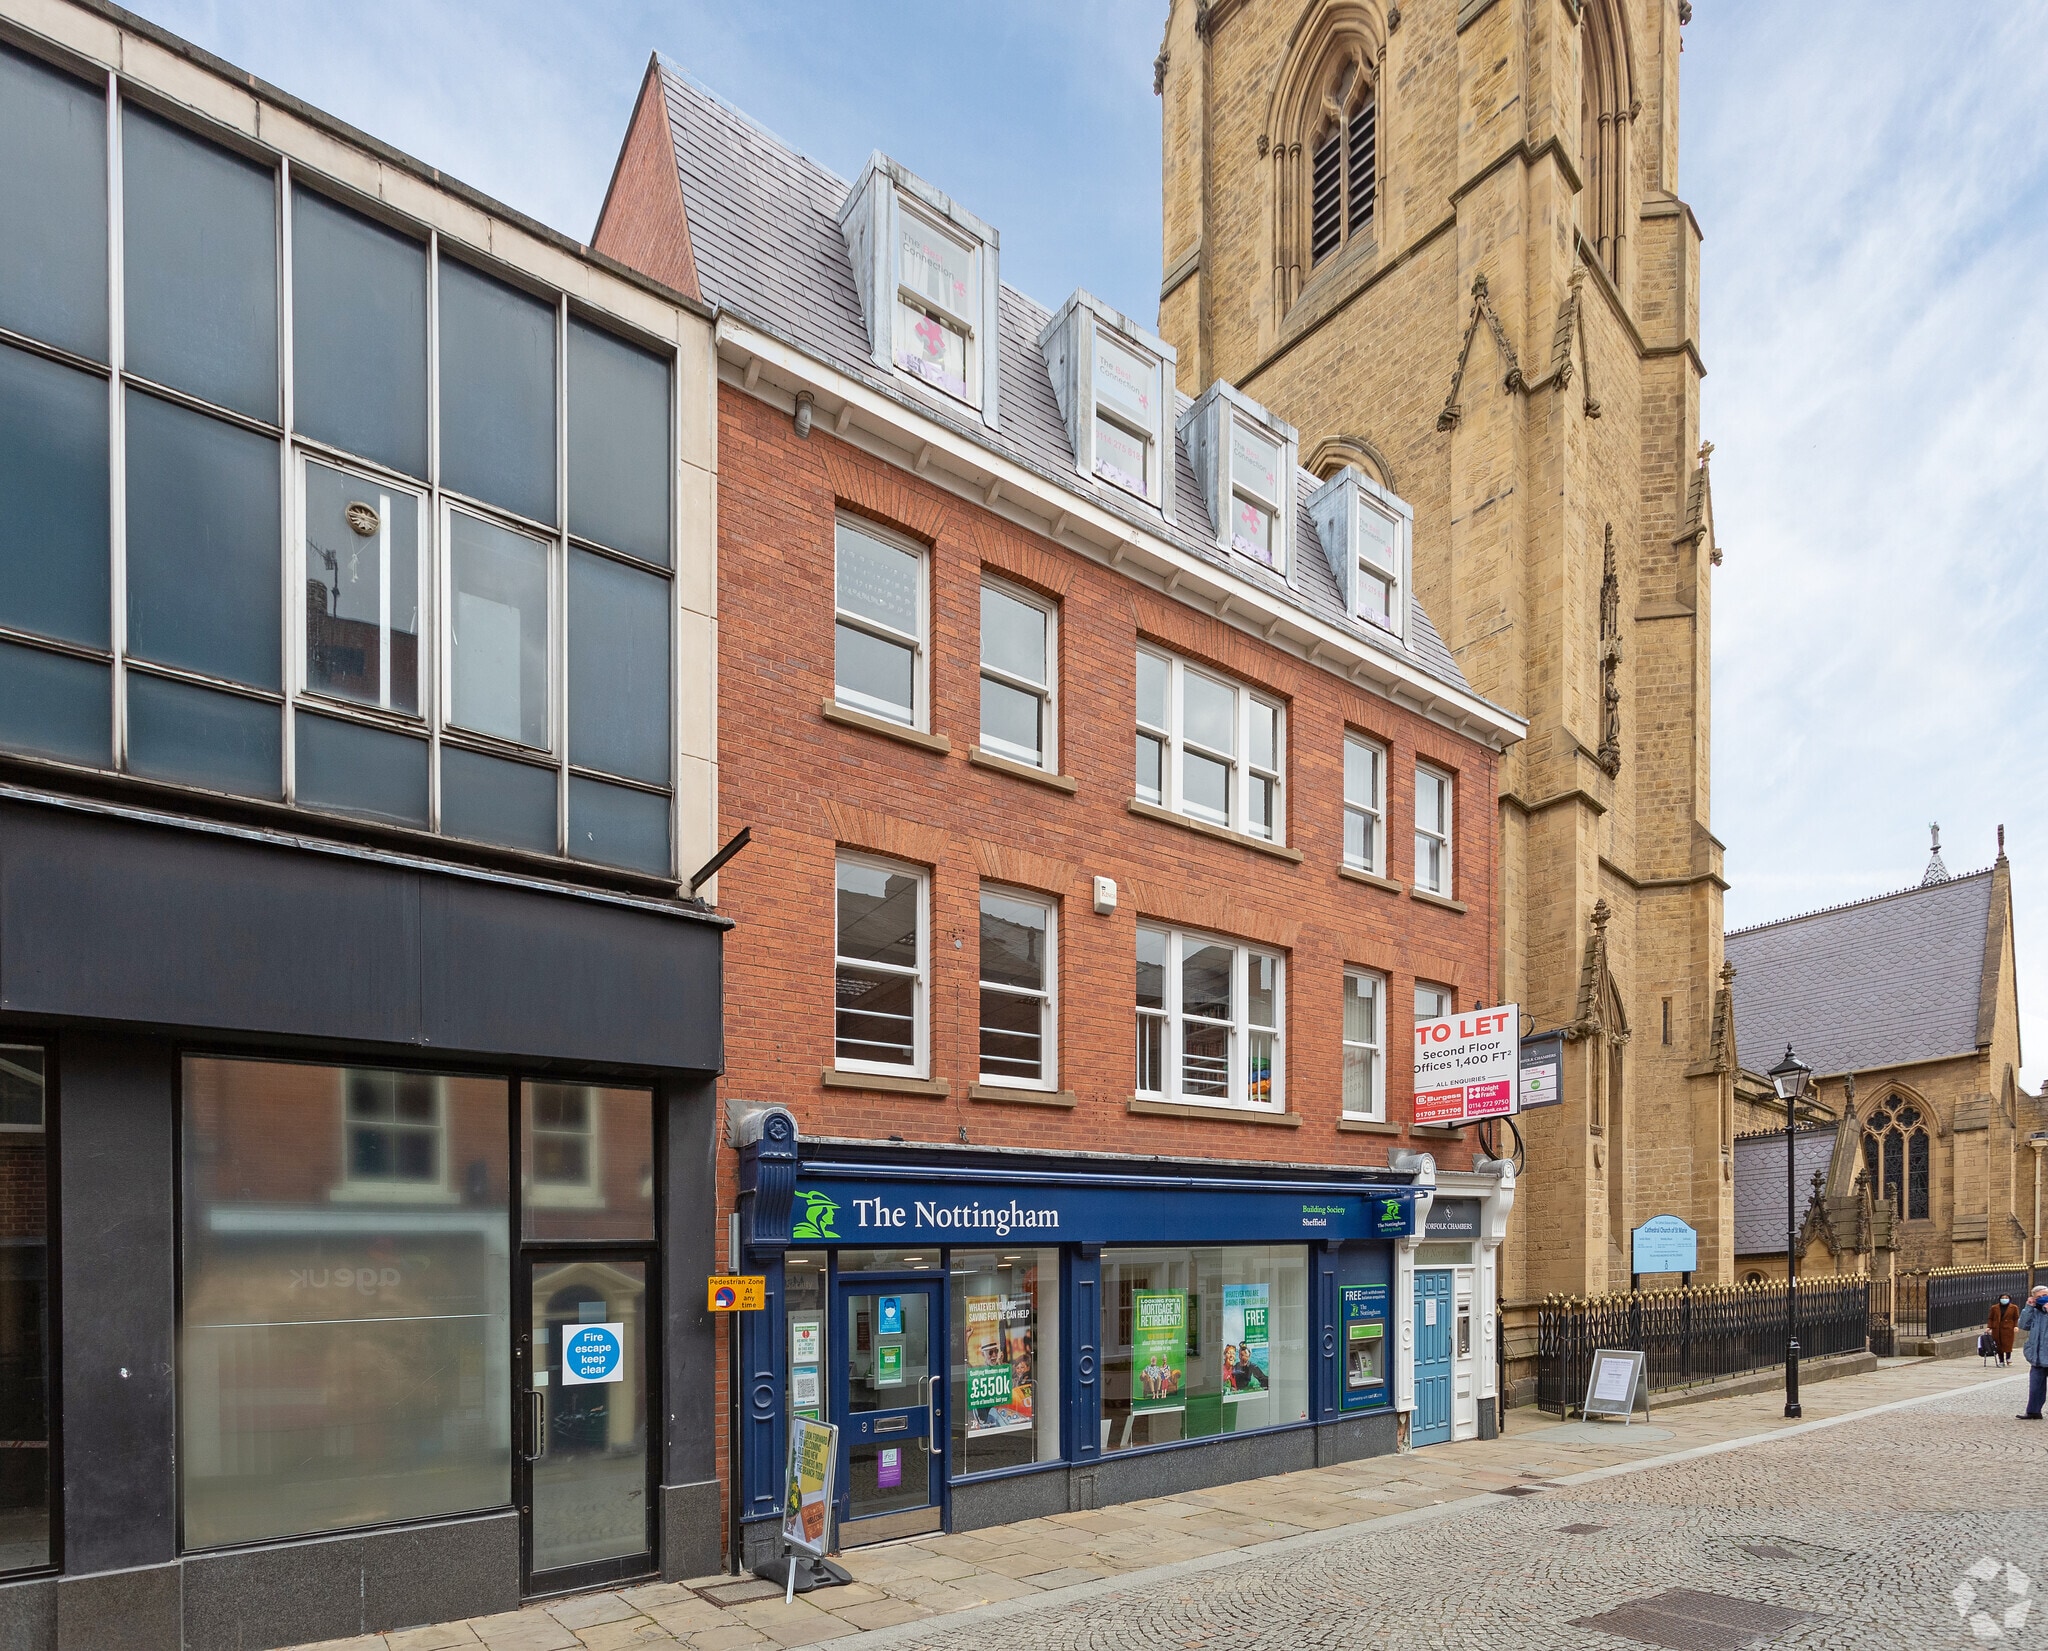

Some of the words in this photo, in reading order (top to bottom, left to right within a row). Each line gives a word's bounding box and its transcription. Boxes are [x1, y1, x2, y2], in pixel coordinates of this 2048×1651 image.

[904, 231, 920, 248] The
[903, 242, 954, 280] Connection
[1100, 356, 1113, 370] The
[1100, 366, 1140, 395] Connection
[1416, 1023, 1451, 1045] TO
[1460, 1013, 1509, 1038] LET
[1423, 1045, 1465, 1060] Second
[1469, 1041, 1500, 1053] Floor
[1414, 1061, 1452, 1074] Offices
[1456, 1054, 1488, 1069] 1,400
[1450, 1075, 1486, 1087] ENQUIRIES
[1480, 1085, 1499, 1093] Knight
[1427, 1093, 1461, 1103] Burgess
[853, 1196, 906, 1227] The
[914, 1199, 1059, 1236] Nottingham
[1302, 1205, 1326, 1215] Building
[1326, 1205, 1345, 1215] Society
[1302, 1218, 1327, 1226] Sheffield
[1424, 1222, 1447, 1230] NORFOLK
[1447, 1222, 1472, 1230] CHAMBERS
[1226, 1290, 1245, 1298] WHATEVER
[1345, 1290, 1361, 1301] FREE
[969, 1301, 995, 1312] WHATEVER
[996, 1301, 1006, 1311] YOU
[1007, 1301, 1016, 1310] ARE
[1140, 1303, 1173, 1315] MORTGAGE
[1174, 1302, 1181, 1314] IN
[969, 1312, 987, 1322] SAVING
[987, 1311, 997, 1321] FOR
[998, 1311, 1006, 1320] WE
[1007, 1310, 1016, 1319] CAN
[1017, 1309, 1030, 1318] HELP
[1245, 1310, 1265, 1326] FREE
[1360, 1309, 1381, 1317] Nottingham
[1140, 1314, 1181, 1327] RETIREMENT?
[583, 1333, 604, 1342] Fire
[575, 1344, 612, 1354] escape
[581, 1355, 606, 1364] keep
[581, 1365, 606, 1375] clear
[970, 1375, 1010, 1399] £550k
[861, 1422, 868, 1433] 9
[804, 1430, 812, 1440] LOOK
[812, 1432, 828, 1446] FORWARD
[803, 1439, 822, 1452] WELCOMING
[803, 1466, 815, 1478] BRANCH
[807, 1512, 824, 1525] WELCOME
